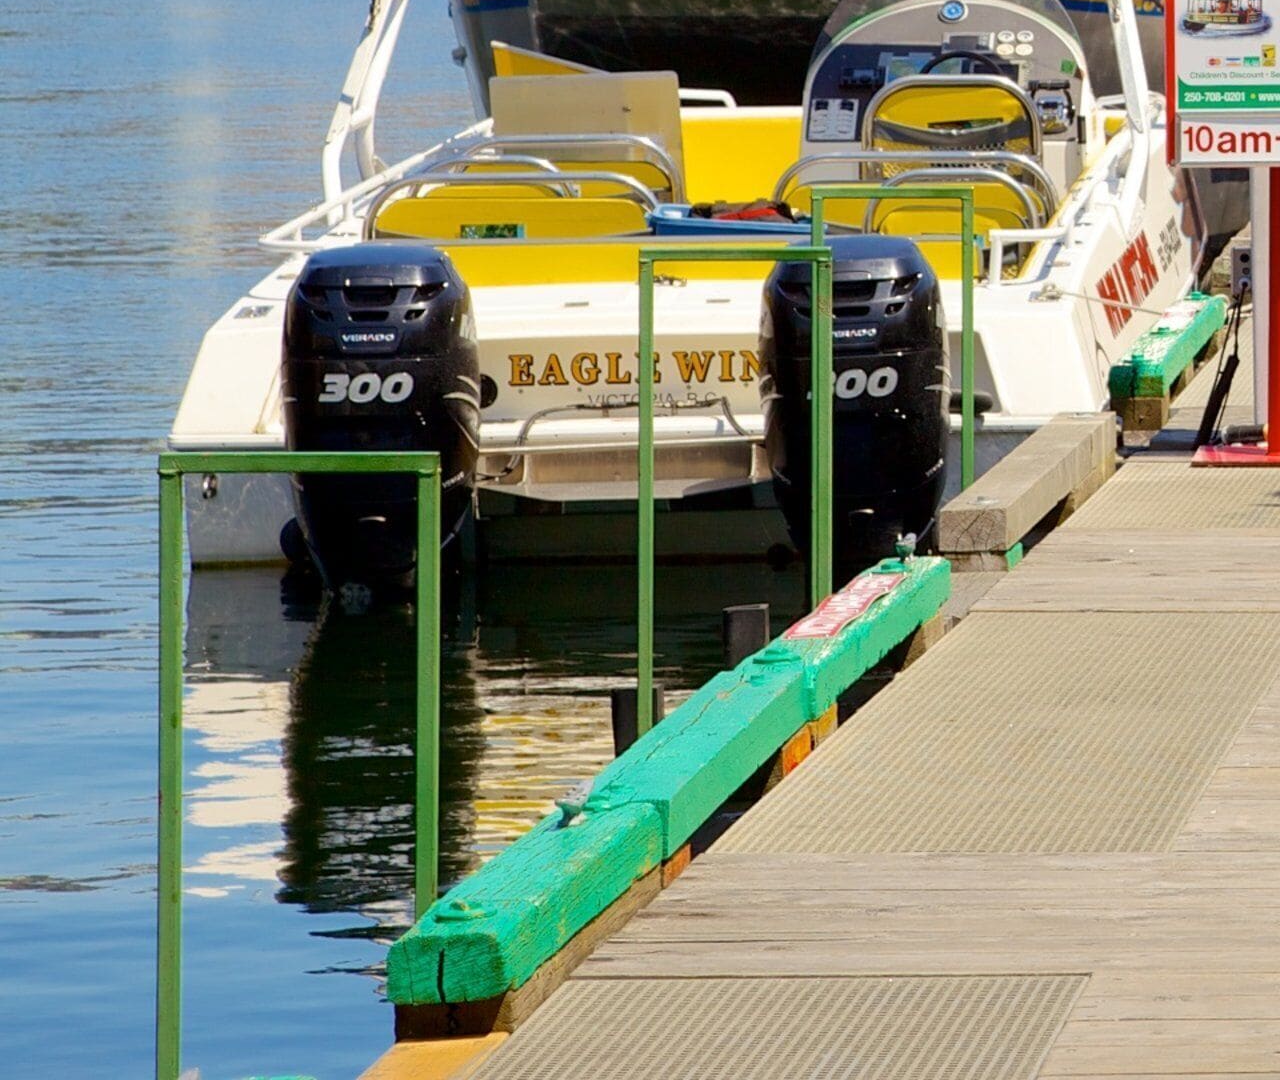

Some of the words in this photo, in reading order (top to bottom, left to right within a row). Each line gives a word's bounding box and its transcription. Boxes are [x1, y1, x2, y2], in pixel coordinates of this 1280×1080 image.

[1190, 71, 1228, 79] Children's
[1184, 92, 1246, 102] 250-708-0201
[341, 333, 396, 343] VERADO
[832, 328, 877, 338] ERADO
[509, 352, 661, 387] EAGLE
[672, 350, 762, 383] WIN
[318, 371, 415, 404] 300
[807, 366, 899, 400] 00
[587, 392, 674, 406] VICTIA
